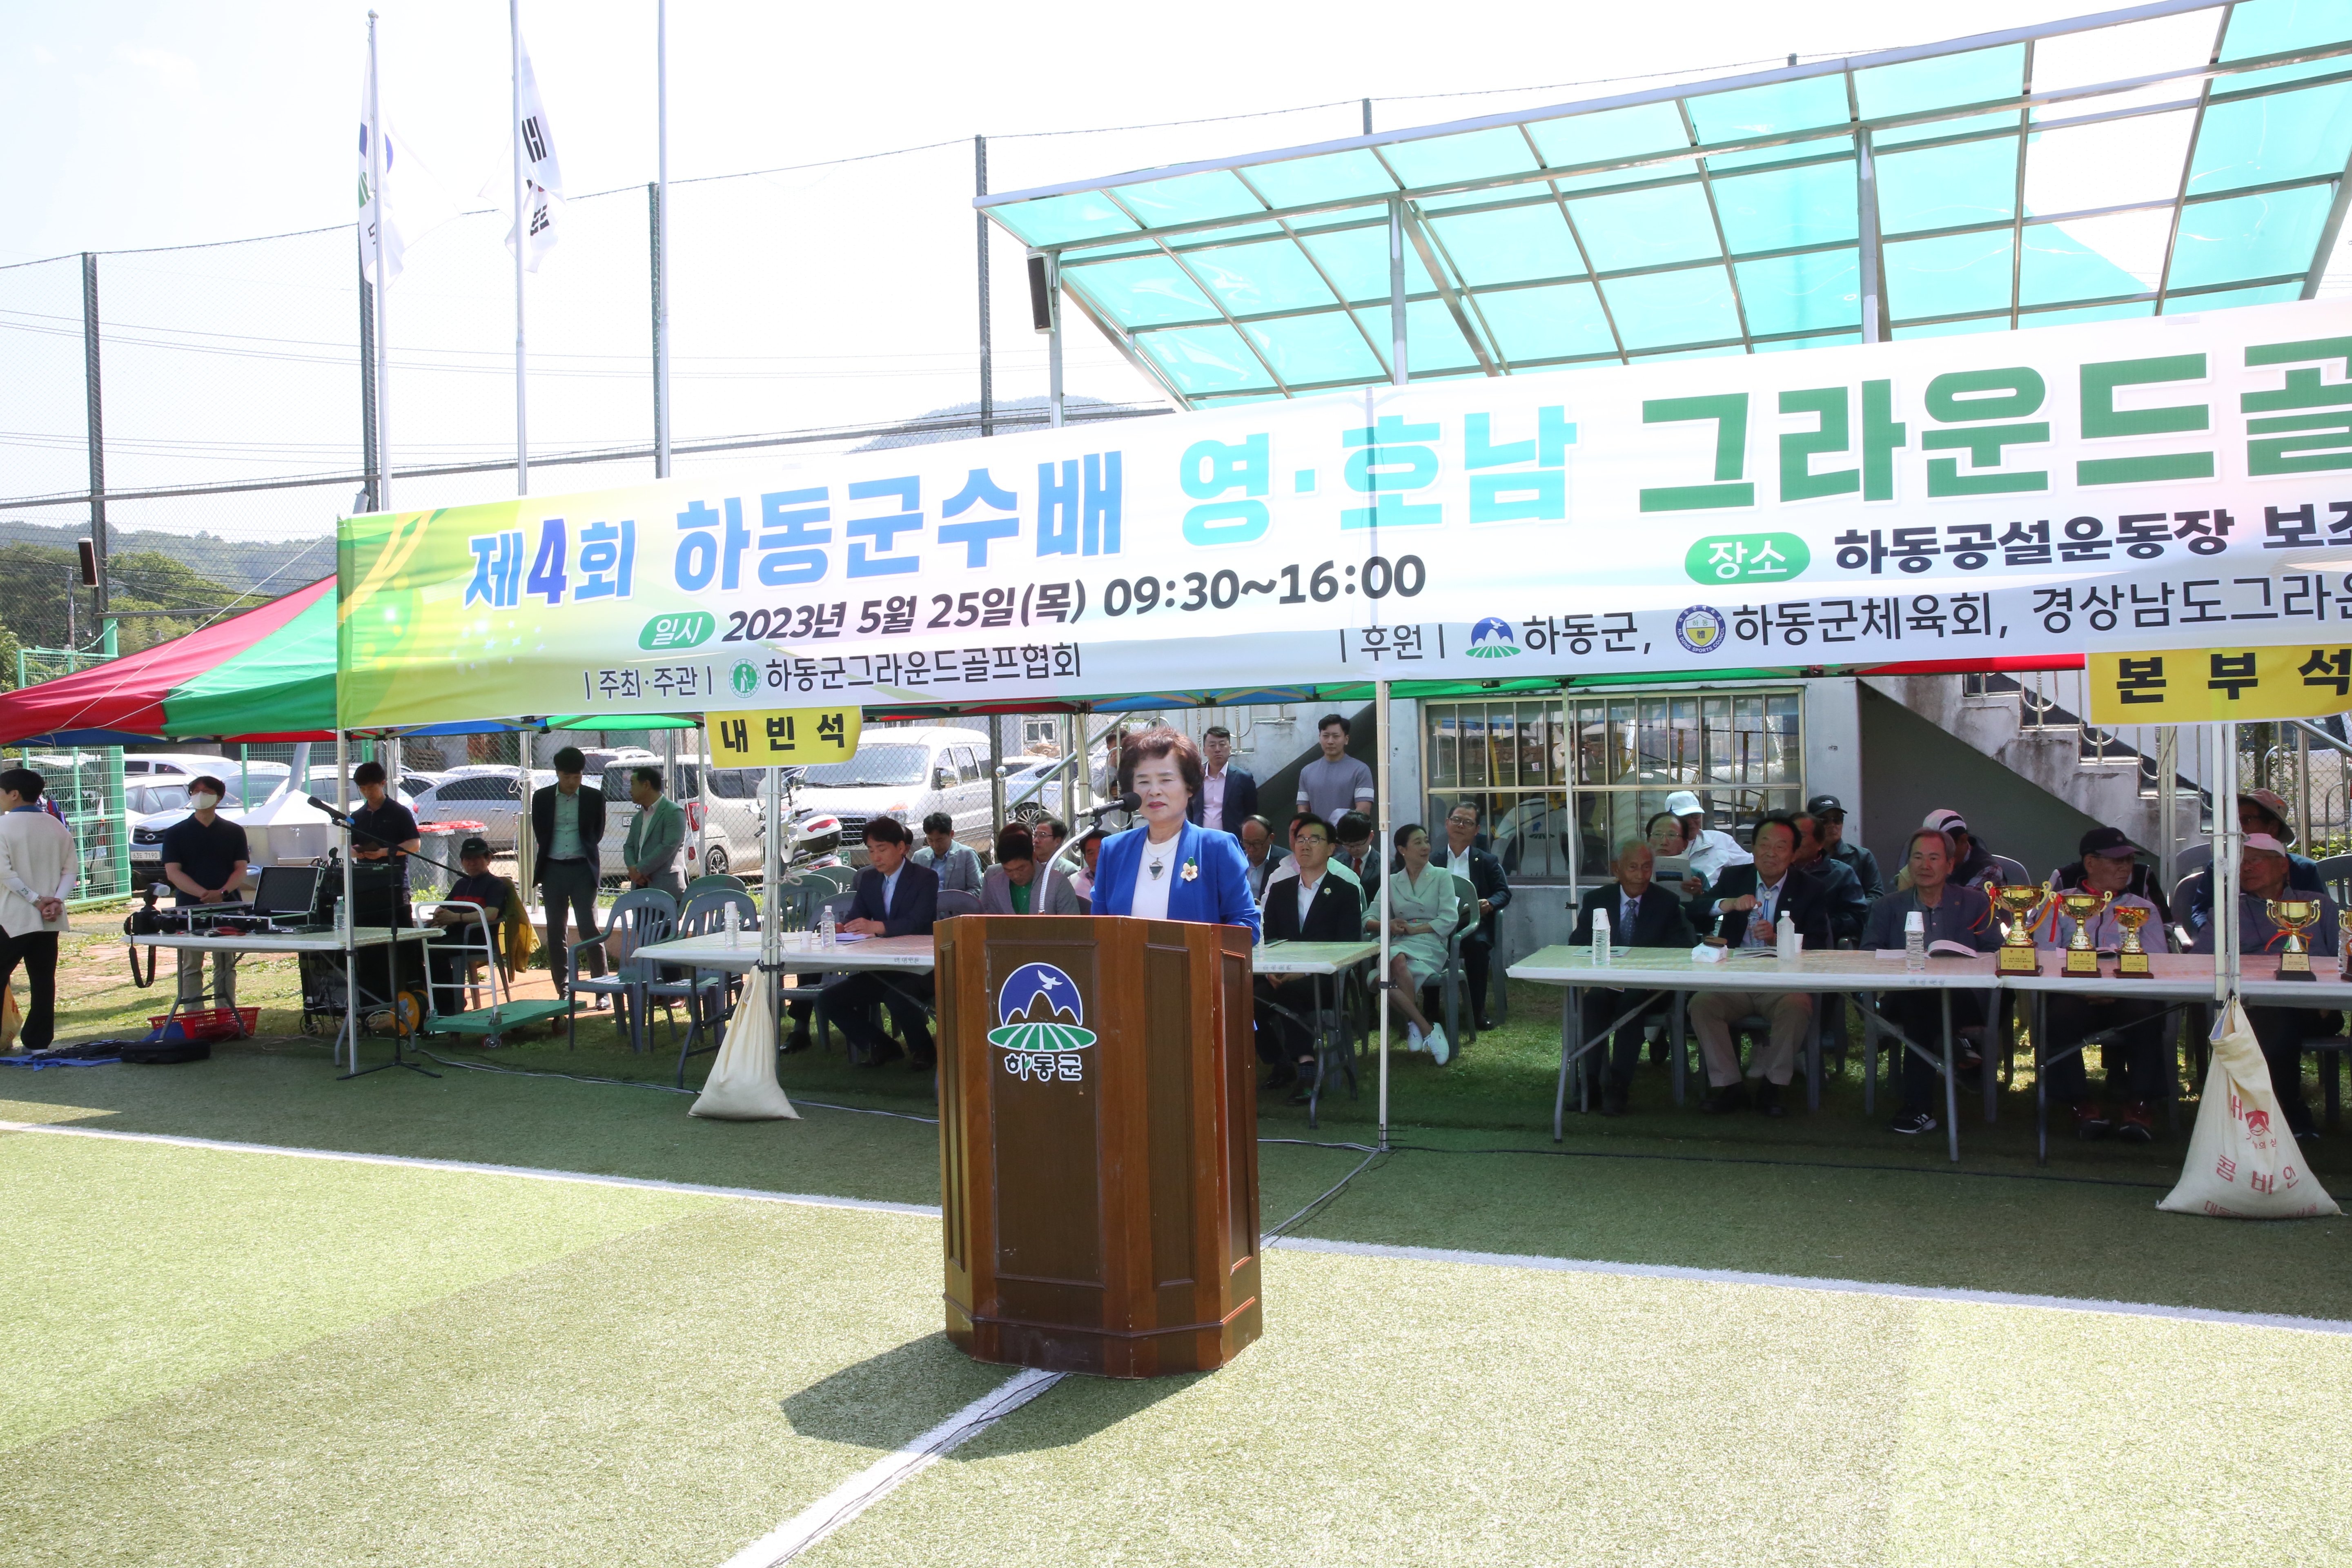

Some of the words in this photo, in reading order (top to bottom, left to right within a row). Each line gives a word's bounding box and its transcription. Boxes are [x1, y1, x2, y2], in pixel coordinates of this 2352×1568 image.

[463, 518, 636, 609] 제4회
[675, 450, 1124, 593] 하동군수배
[1639, 336, 2352, 512] 그라운드골
[1708, 541, 1787, 579] 장소
[1835, 509, 2235, 575] 하동공설운동장
[651, 620, 702, 646] 일시
[722, 601, 846, 642] 2023년
[857, 595, 916, 634] 5월
[926, 578, 1086, 630] 25일(목)
[1104, 554, 1427, 617] 09:30~16:00
[1735, 590, 2007, 646] 하동군체육회,
[1361, 625, 1423, 661] 후원
[1523, 612, 1651, 655] 하동군,
[1679, 636, 1691, 649] DONG
[1713, 627, 1725, 648] COUNCIL
[766, 642, 1081, 692] 하동군그라운드골프협회
[1004, 1053, 1082, 1082] 하동군
